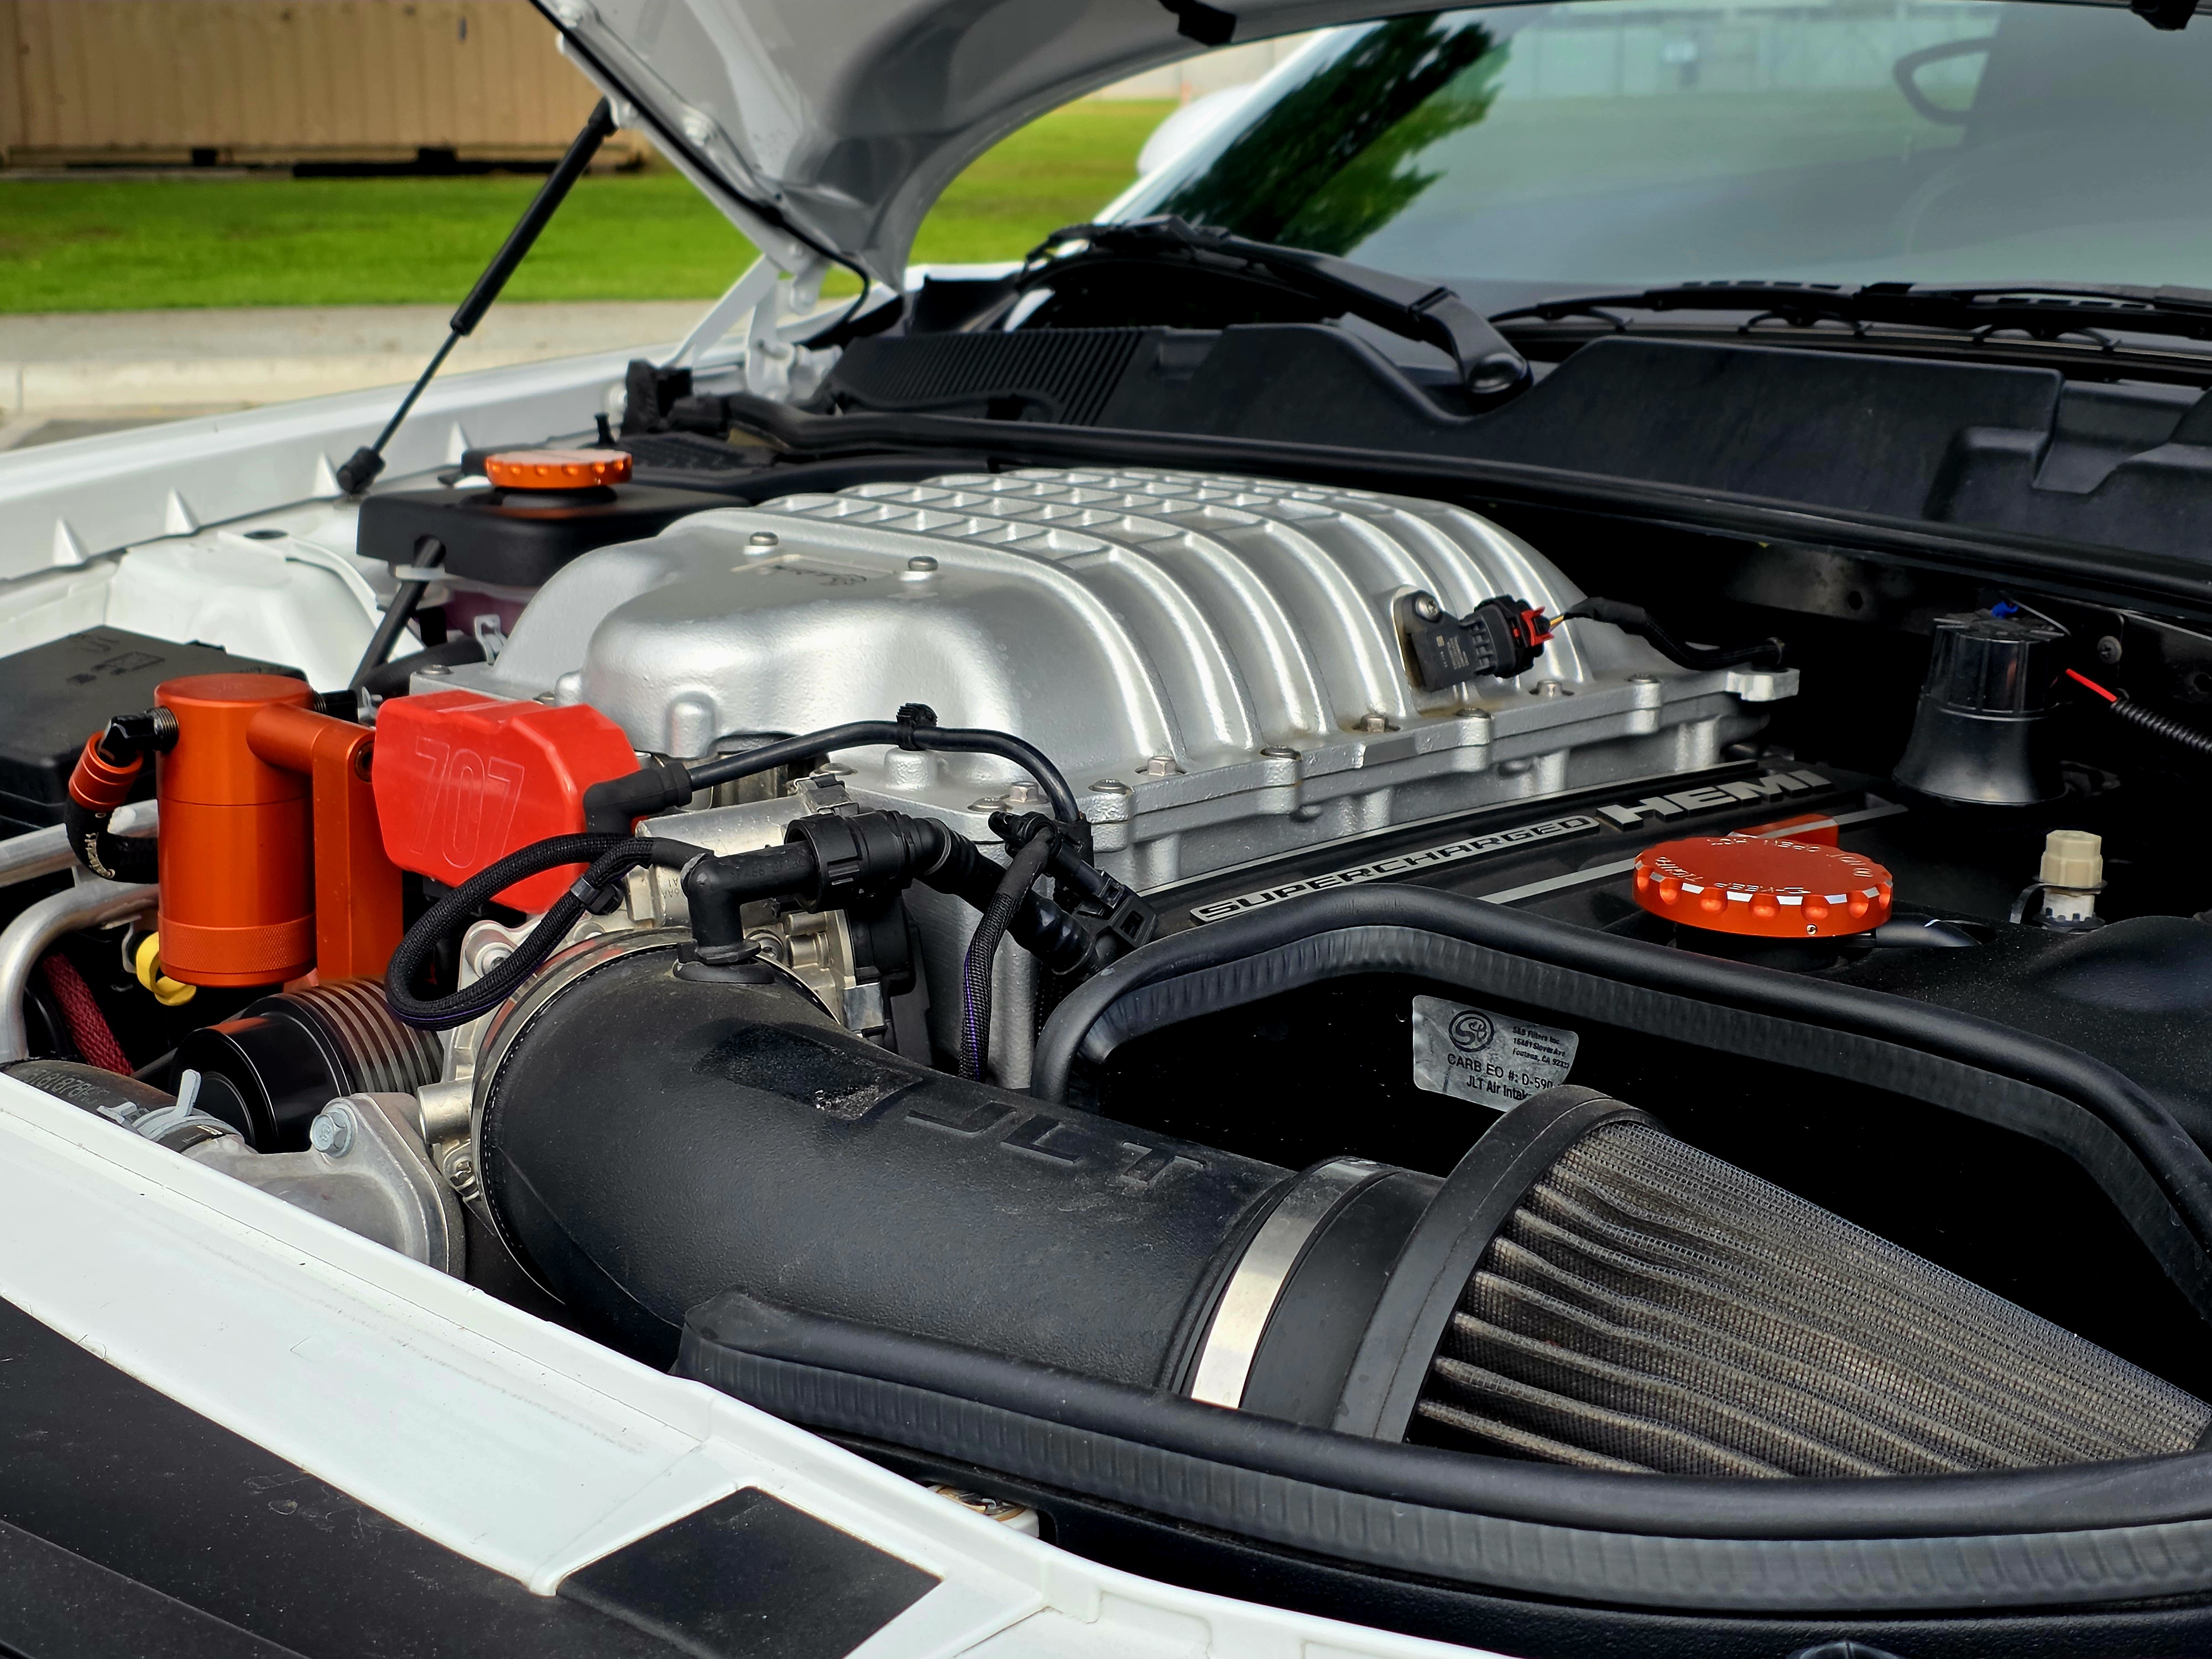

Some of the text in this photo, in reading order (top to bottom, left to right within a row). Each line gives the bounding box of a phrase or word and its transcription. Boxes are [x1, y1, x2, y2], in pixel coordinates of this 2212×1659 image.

[410, 736, 525, 868] 707
[1197, 769, 1833, 919] SUPERCHARGED HEMI
[1447, 1053, 1482, 1073] CARB
[1486, 1062, 1504, 1078] EO
[1507, 1070, 1519, 1083] #:
[1466, 1075, 1532, 1101] JLT Air Intak
[1541, 1055, 1551, 1065] CA
[904, 1100, 1207, 1186] JLT
